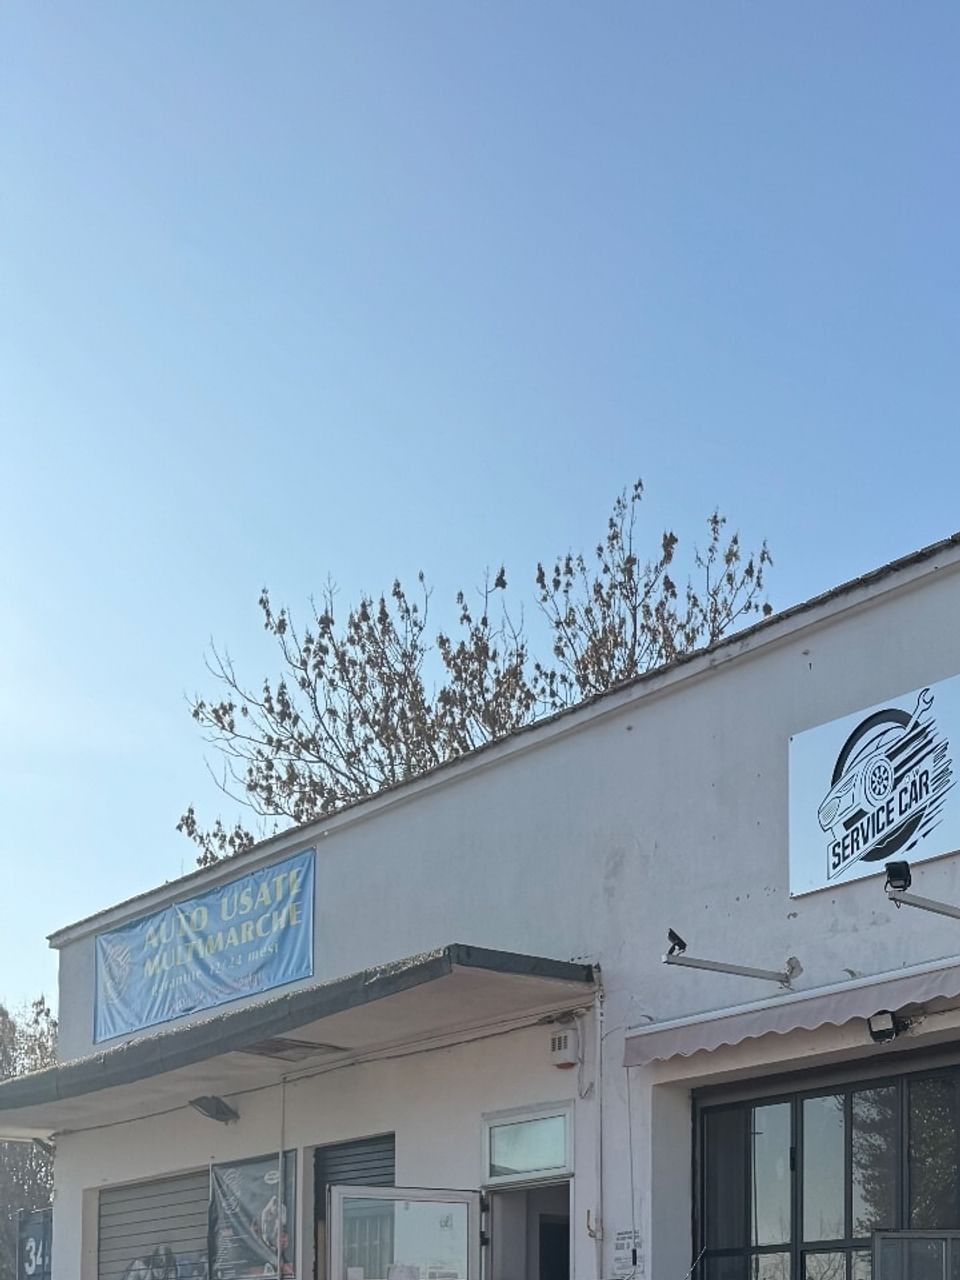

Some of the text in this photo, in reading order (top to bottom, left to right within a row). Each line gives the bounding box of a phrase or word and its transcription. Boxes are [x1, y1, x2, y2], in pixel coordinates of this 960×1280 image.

[831, 769, 930, 870] SERVICE CAR
[143, 867, 303, 949] AUTO USATE
[143, 901, 303, 977] MULTIMARCHE
